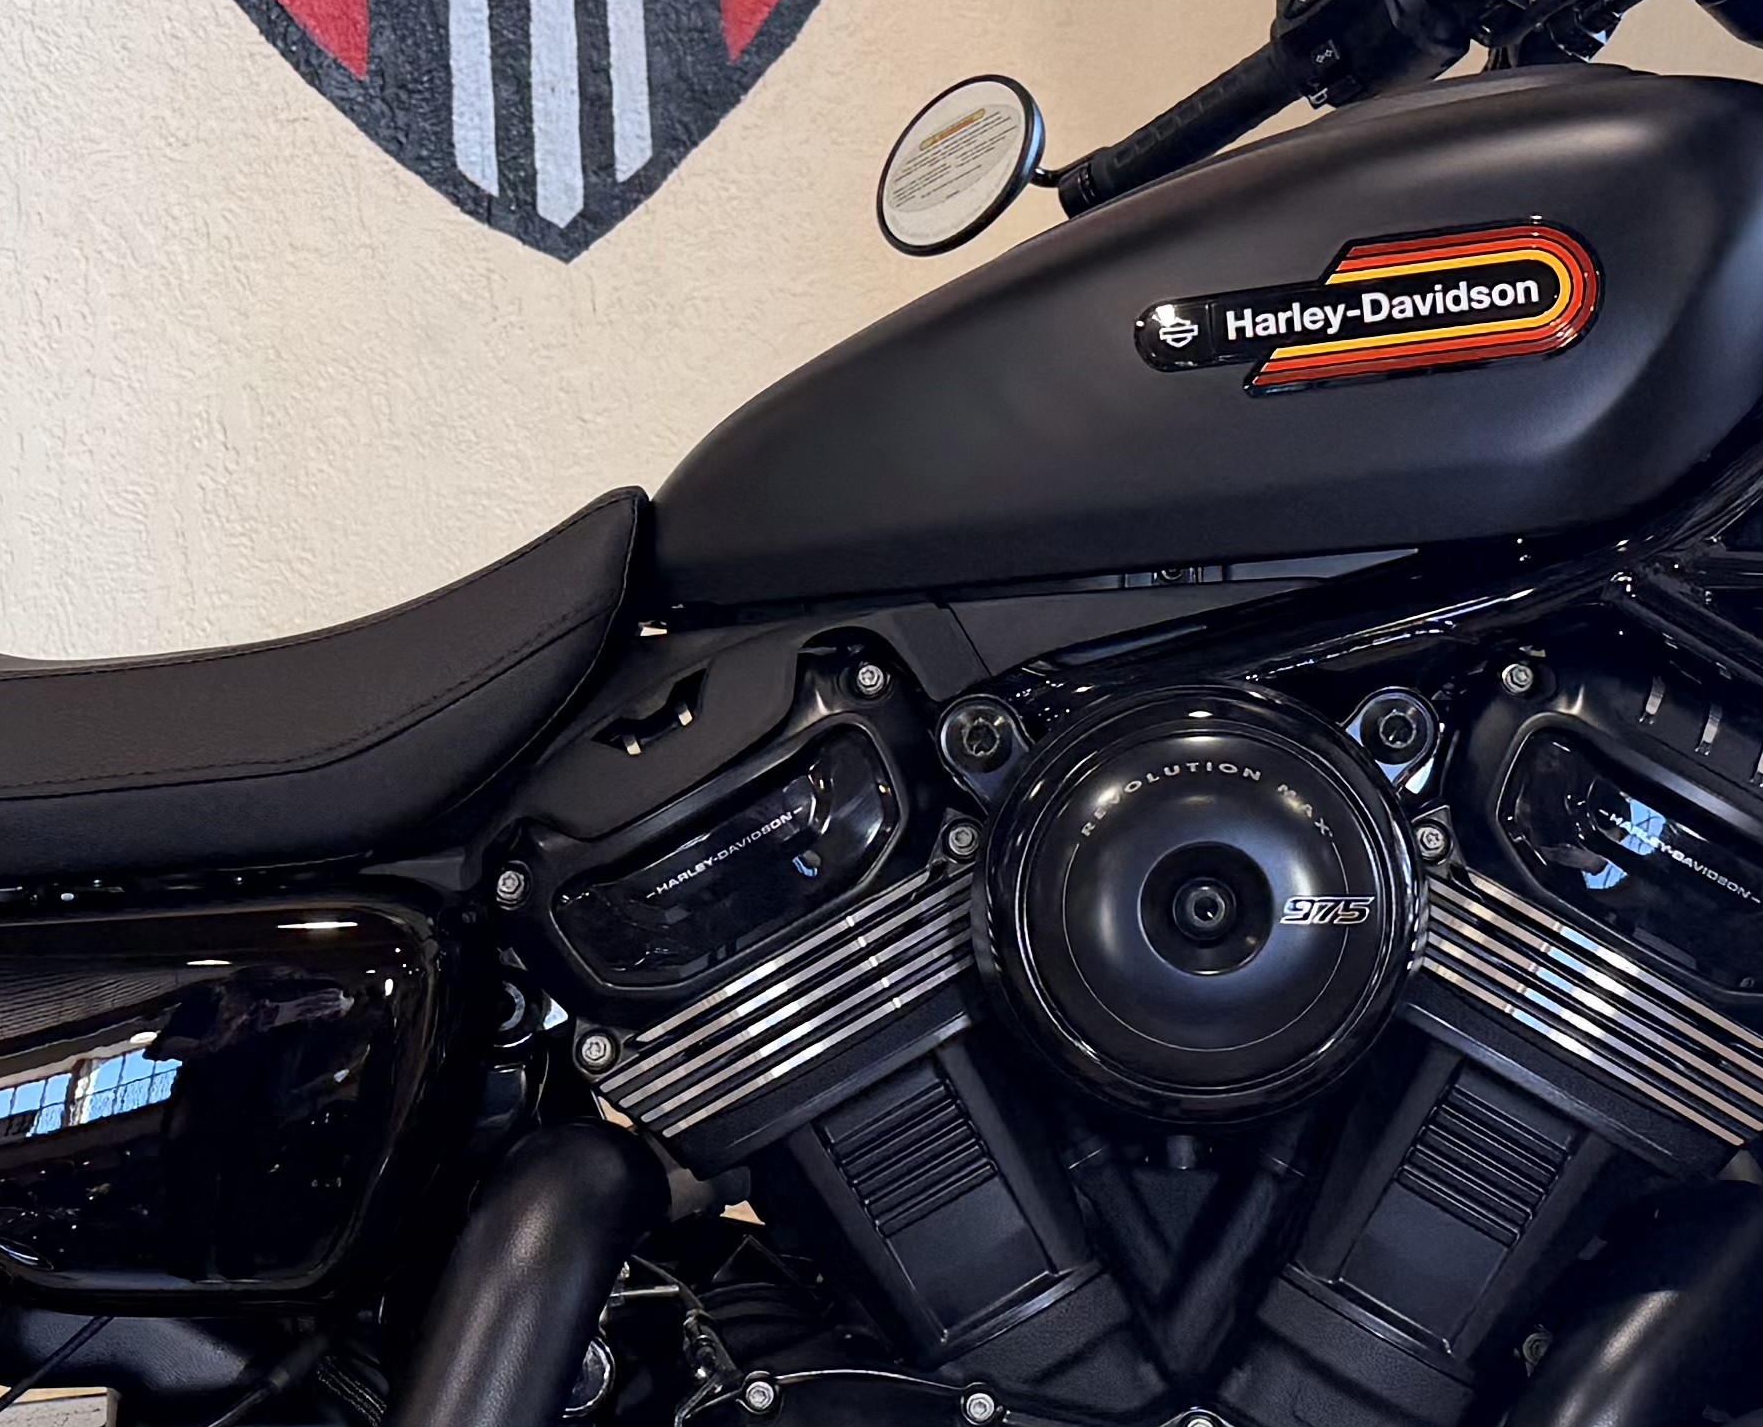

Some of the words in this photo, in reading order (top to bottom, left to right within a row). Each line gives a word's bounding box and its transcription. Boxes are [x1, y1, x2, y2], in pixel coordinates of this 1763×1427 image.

[1225, 277, 1540, 341] Harley-Davidson
[1080, 761, 1261, 837] REVOLUTION
[1276, 783, 1331, 837] MAX
[655, 811, 794, 895] HARLEY-DAVIDSON
[1279, 895, 1375, 925] 975
